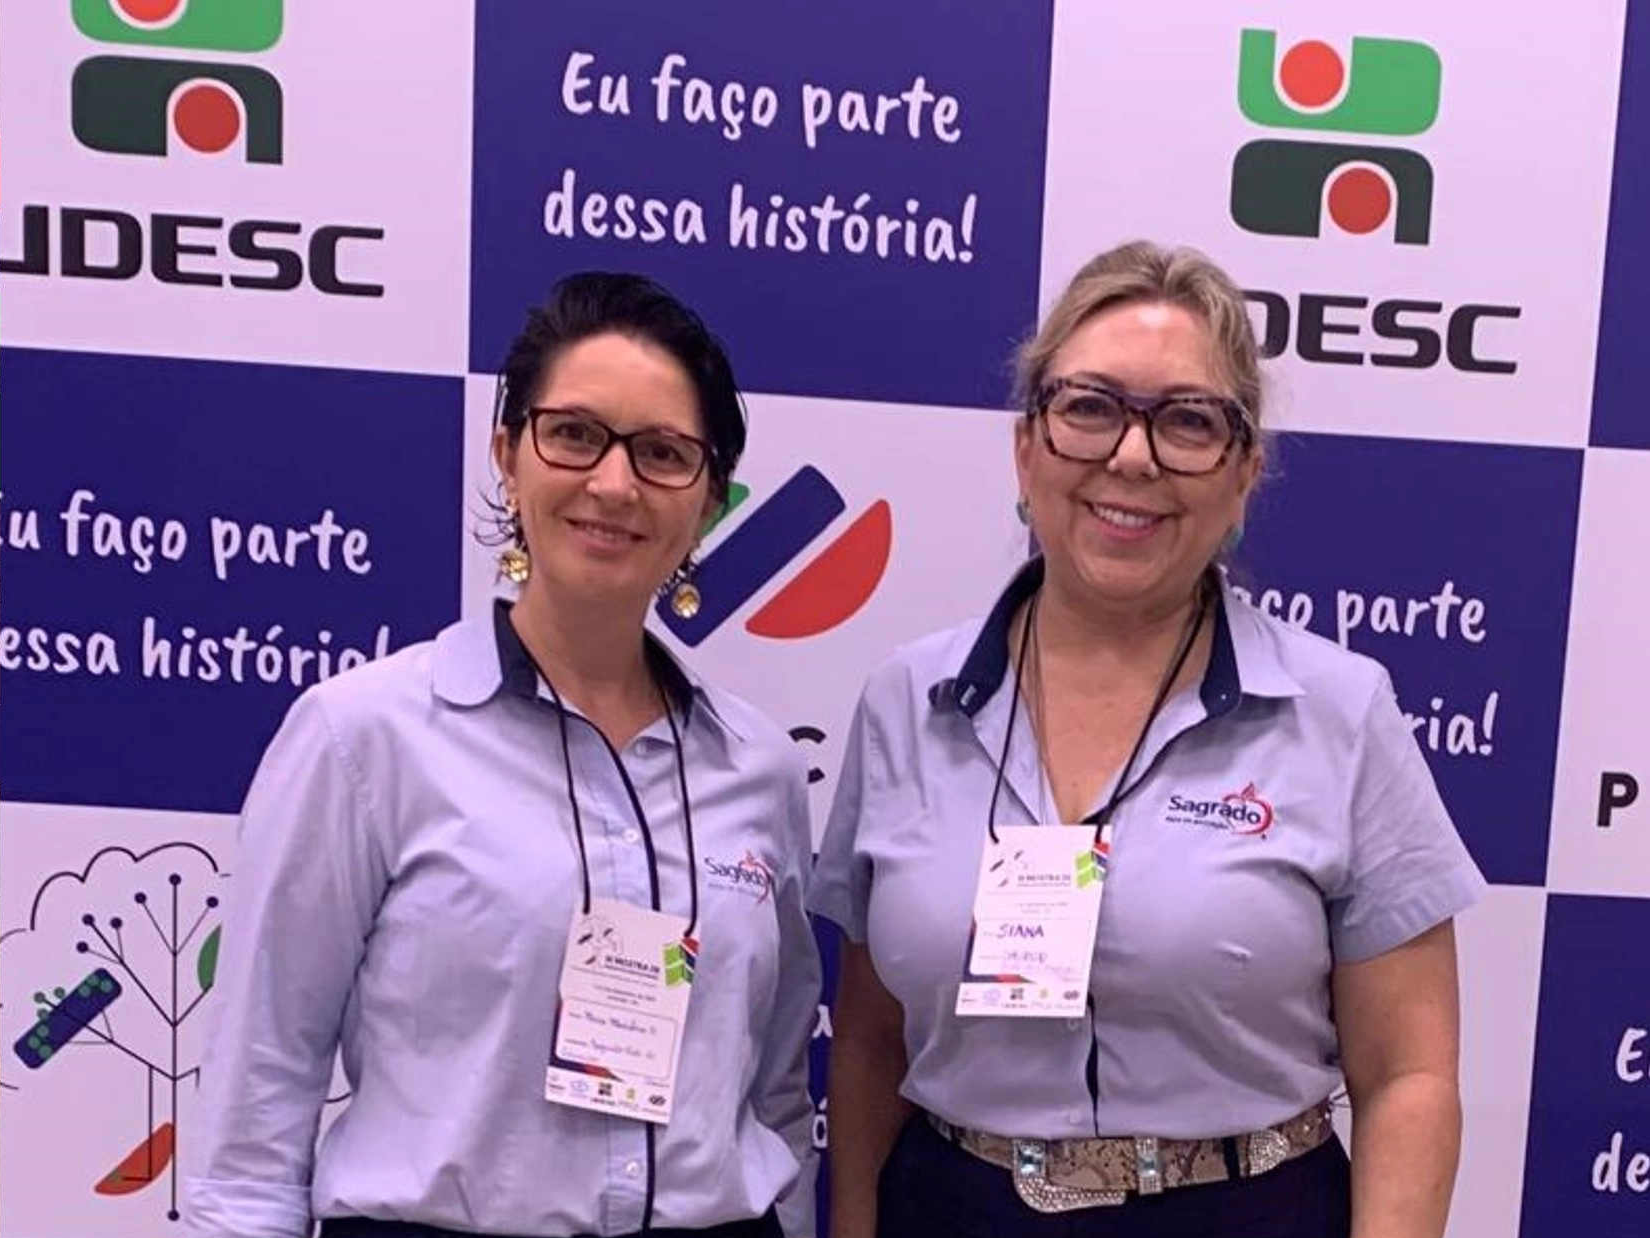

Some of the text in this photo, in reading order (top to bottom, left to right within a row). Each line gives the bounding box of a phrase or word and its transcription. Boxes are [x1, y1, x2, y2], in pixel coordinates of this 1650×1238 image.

[562, 51, 962, 148] Eu faço parte
[544, 168, 977, 263] dessa história!
[59, 489, 372, 579] faço parte
[1337, 581, 1487, 651] parte
[1168, 795, 1261, 825] Sagrado
[705, 856, 769, 887] Sagrado
[997, 924, 1045, 939] SIANA
[1616, 1027, 1650, 1082] E
